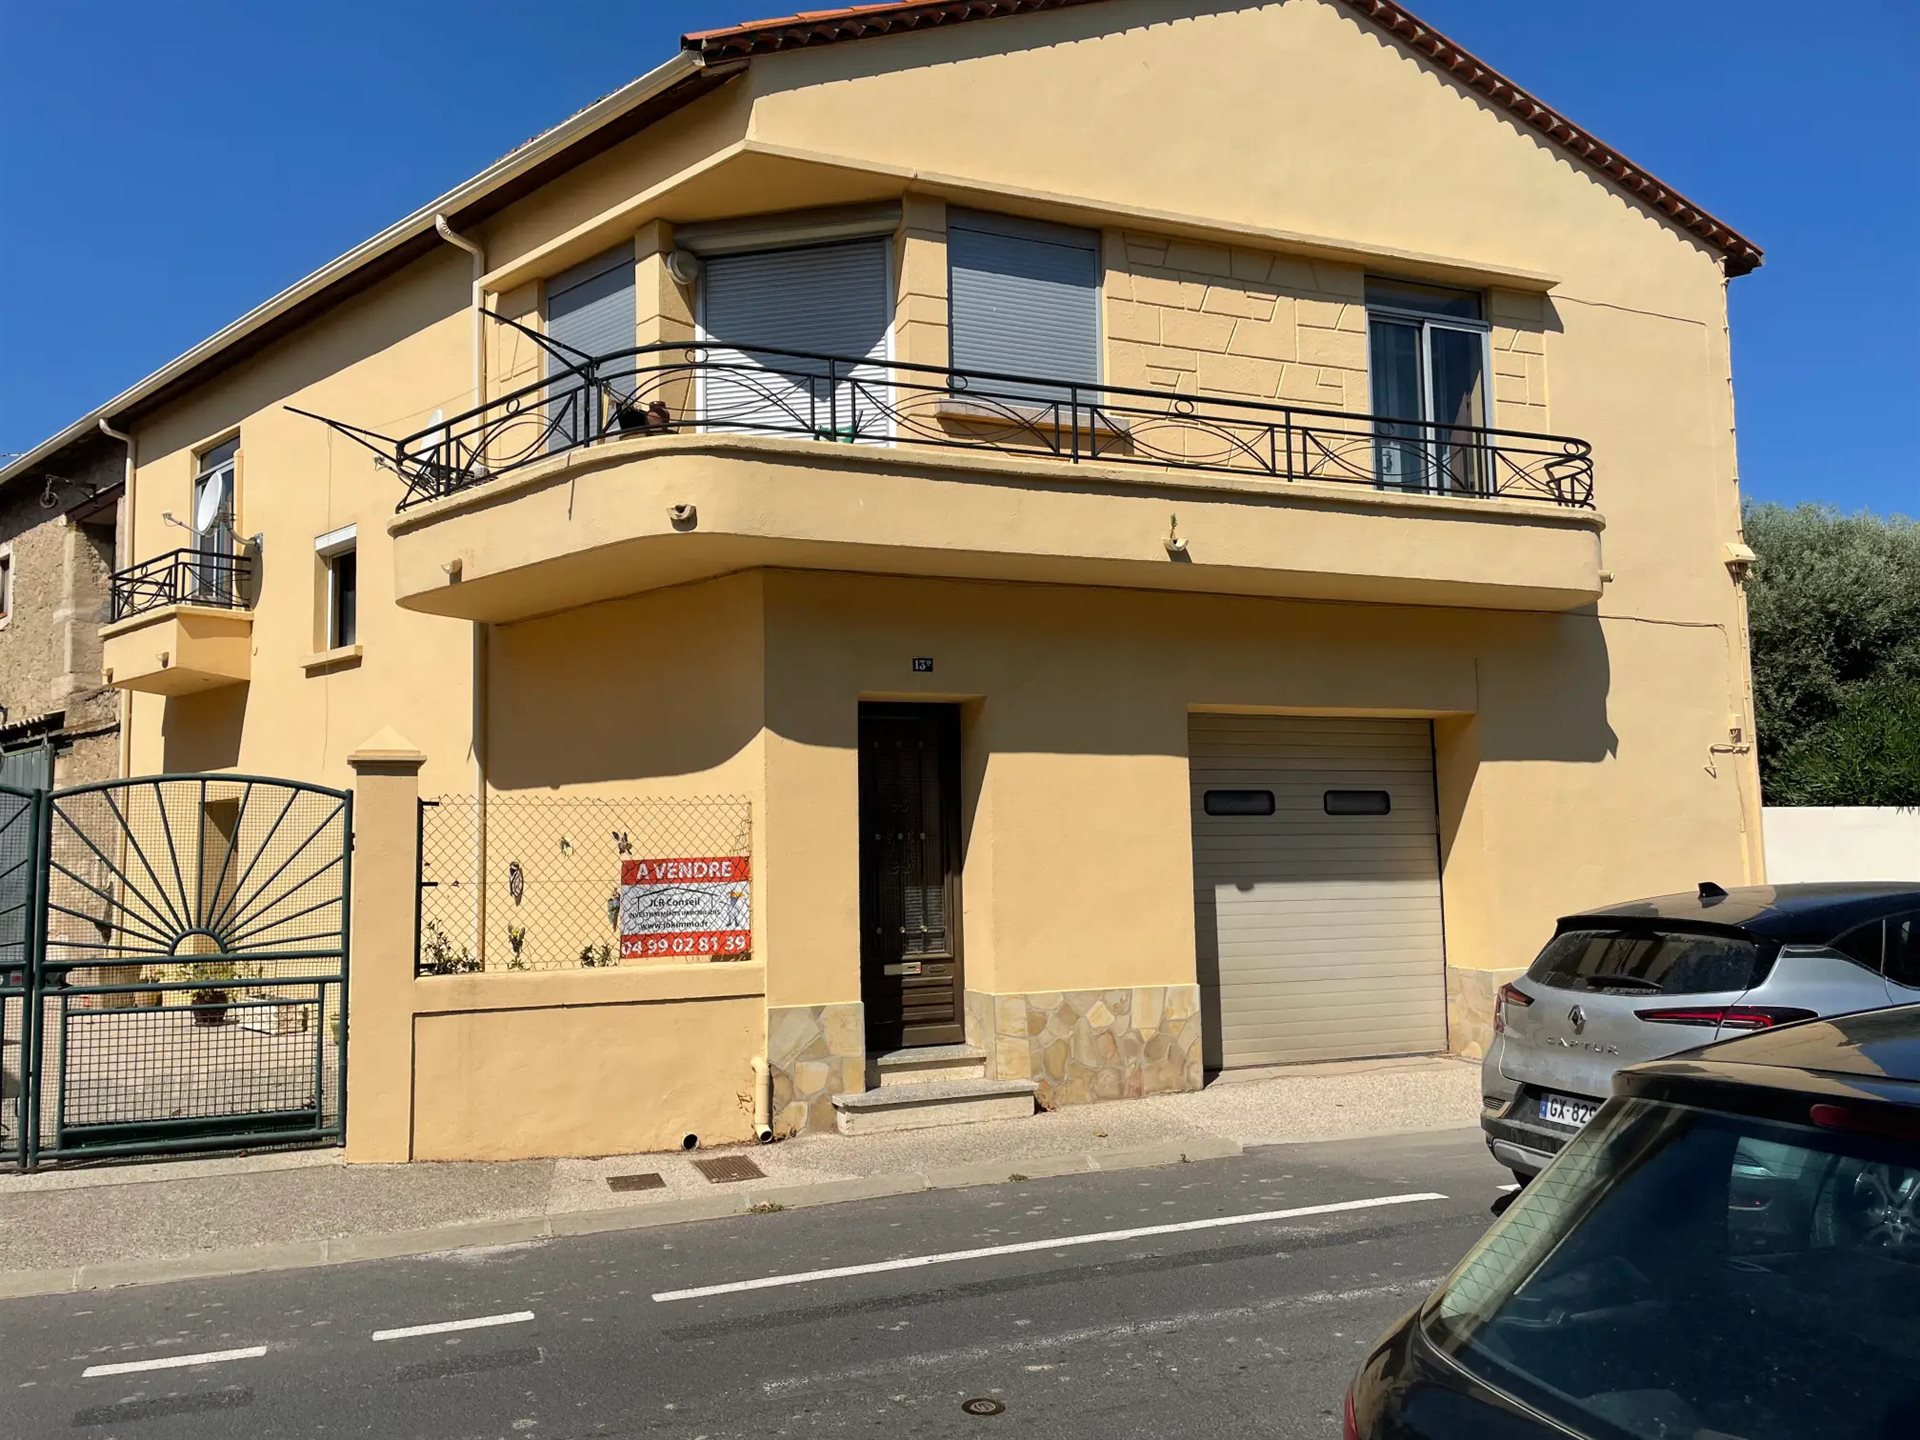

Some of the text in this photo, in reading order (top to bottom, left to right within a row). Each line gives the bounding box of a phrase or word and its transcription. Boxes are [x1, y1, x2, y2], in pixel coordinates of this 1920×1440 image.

[636, 861, 732, 880] A VENDRE
[667, 897, 700, 907] Conseil
[621, 935, 745, 955] 04 99 02 81 39
[1547, 1036, 1619, 1055] CAPTUR
